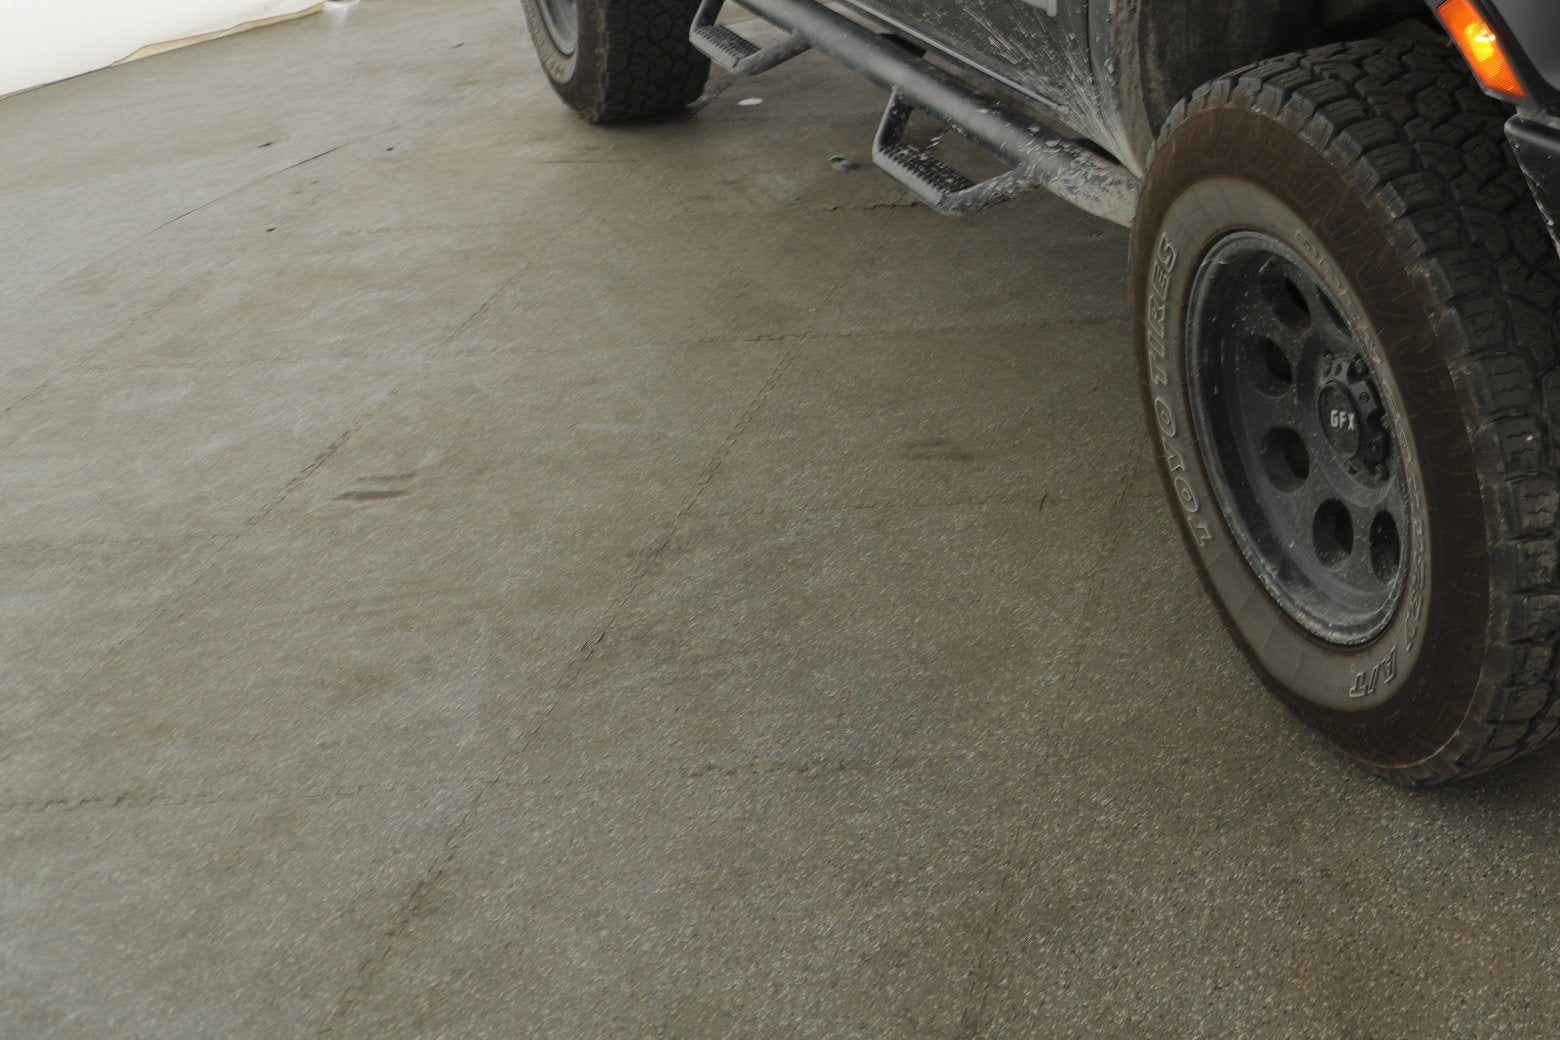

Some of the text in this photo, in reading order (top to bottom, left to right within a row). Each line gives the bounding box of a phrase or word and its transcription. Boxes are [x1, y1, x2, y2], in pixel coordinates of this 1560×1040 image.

[1148, 232, 1212, 548] TOYO TIRES
[1330, 409, 1355, 431] GFX
